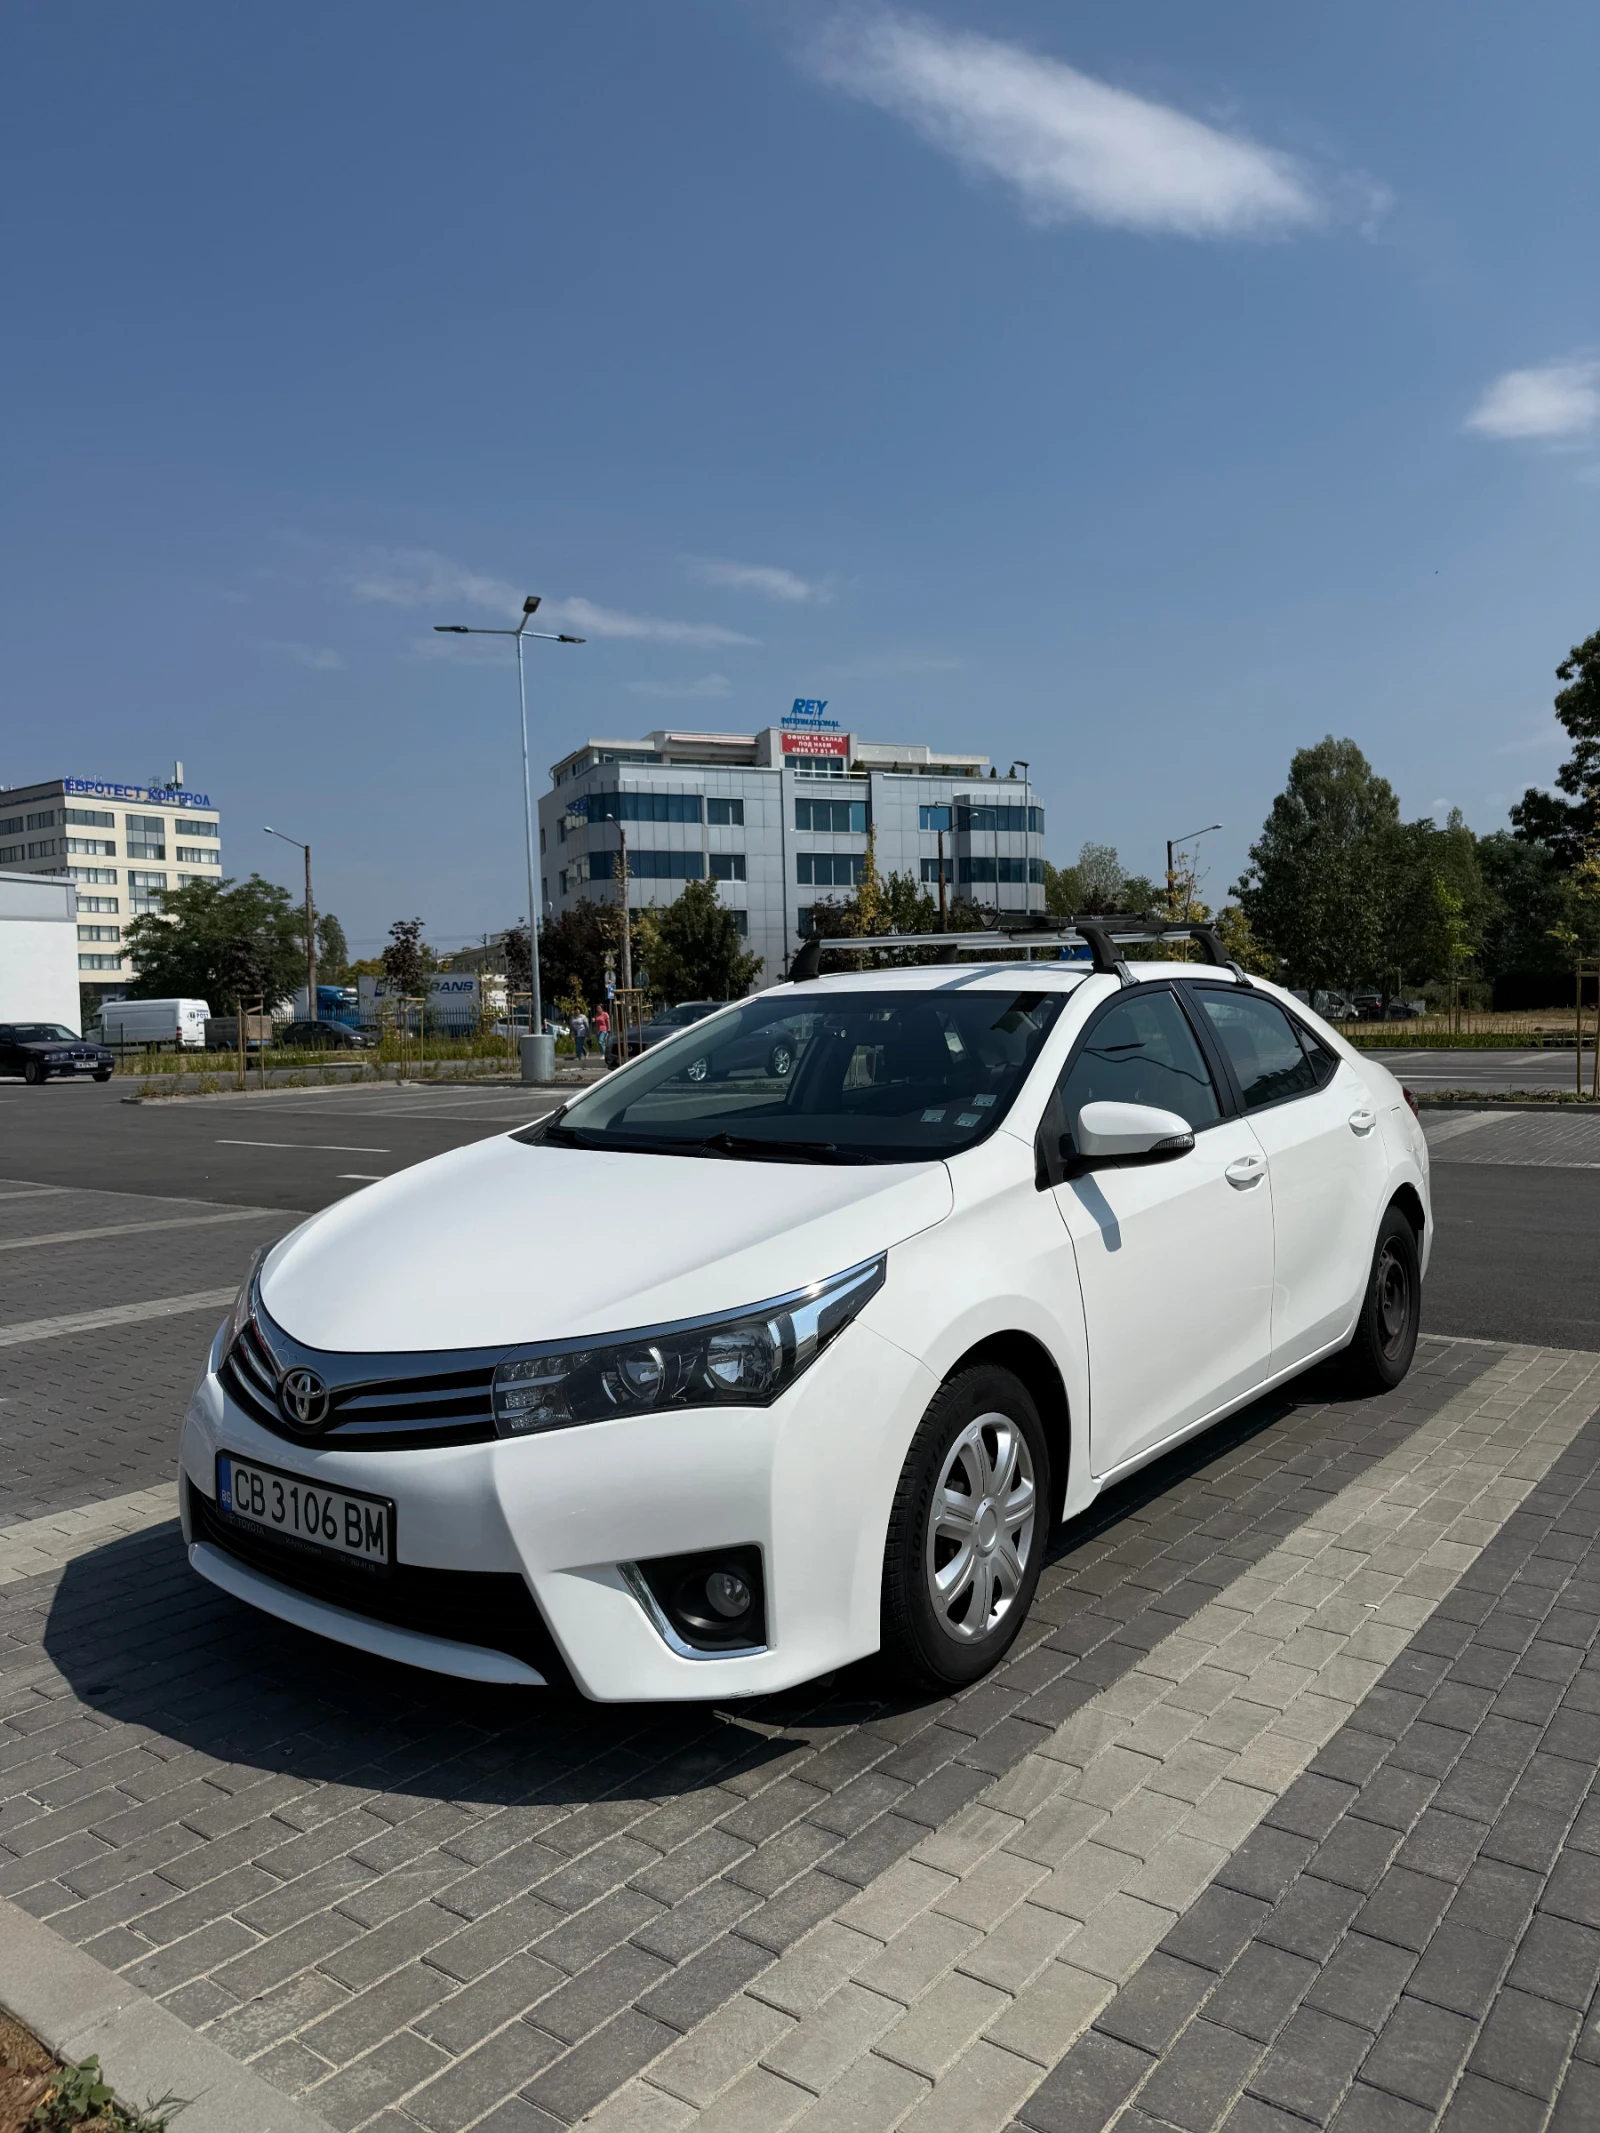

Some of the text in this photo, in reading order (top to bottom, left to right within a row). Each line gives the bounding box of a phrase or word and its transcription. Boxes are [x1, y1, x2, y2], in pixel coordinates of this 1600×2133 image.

[792, 699, 828, 715] REY
[781, 717, 840, 727] INTERNATIONAL
[65, 778, 211, 806] ЕВРОТЕСТ КОНТРОЛ
[222, 1489, 231, 1504] BG
[235, 1469, 384, 1556] CB 3106 BM
[238, 1517, 265, 1536] TOYOTA
